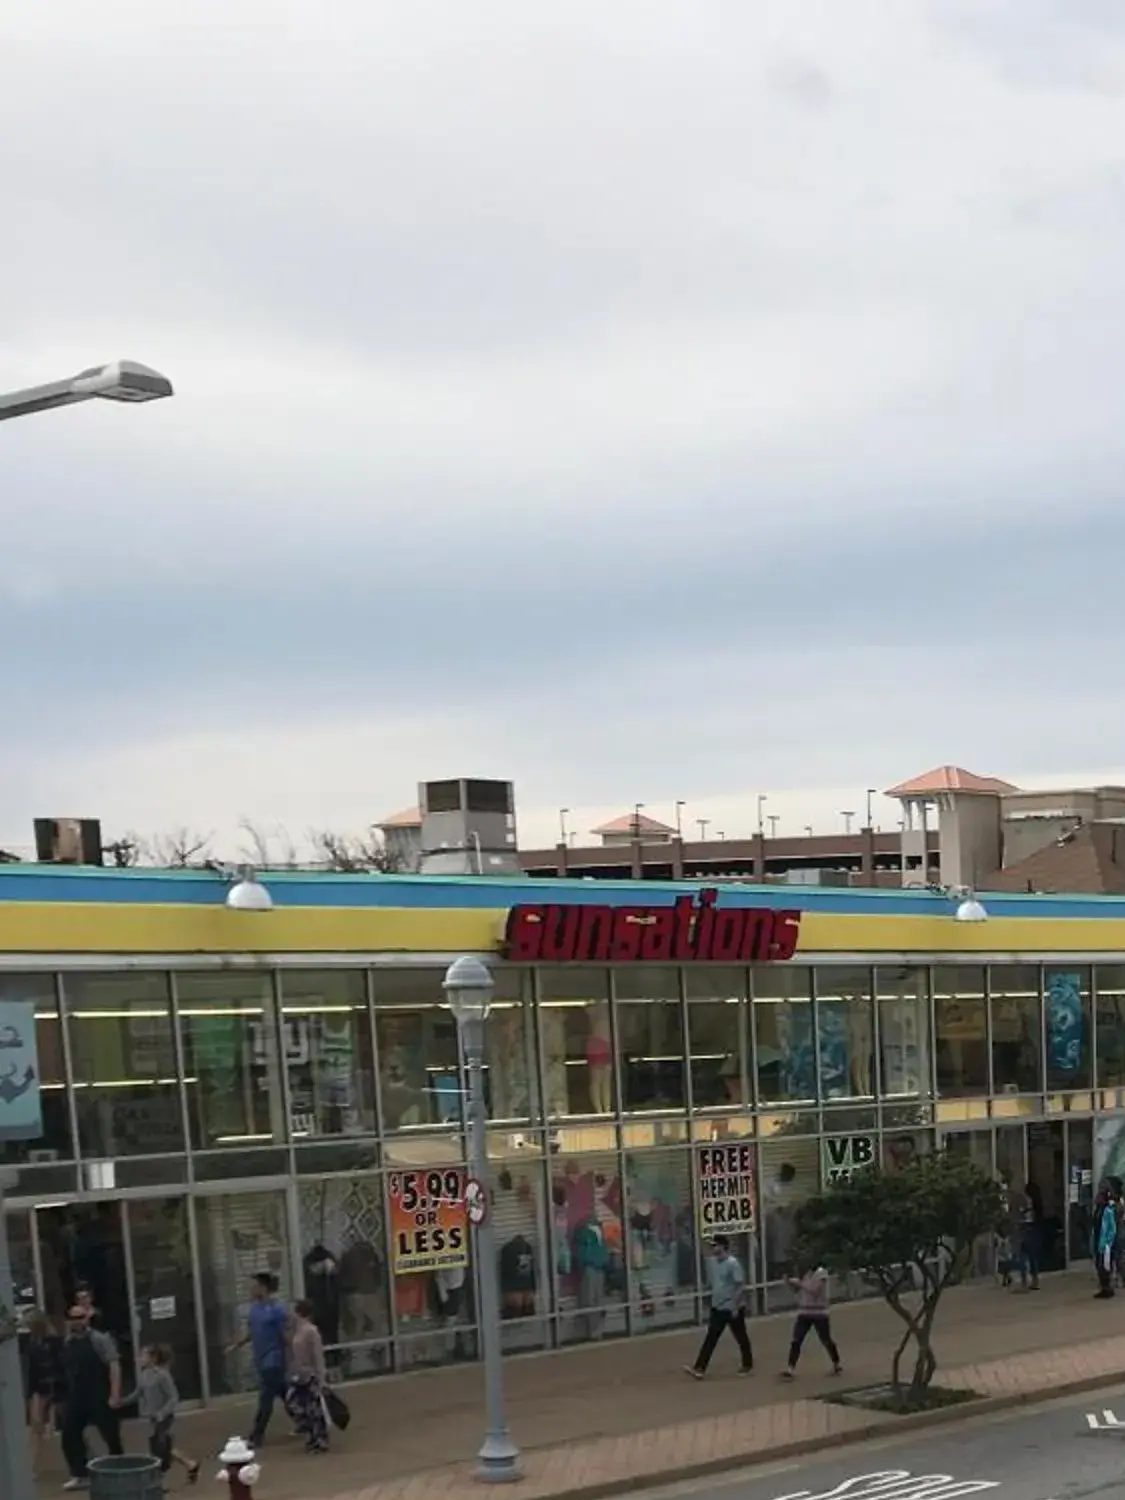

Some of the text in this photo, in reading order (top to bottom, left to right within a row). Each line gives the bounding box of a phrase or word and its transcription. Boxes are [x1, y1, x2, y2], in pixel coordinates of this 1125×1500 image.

[506, 887, 800, 961] sunsations
[701, 1147, 750, 1174] FREE
[827, 1136, 873, 1165] VB
[701, 1176, 751, 1199] HERMIT
[416, 1211, 437, 1226] OR
[703, 1198, 752, 1224] CRAB
[399, 1227, 462, 1255] LESS
